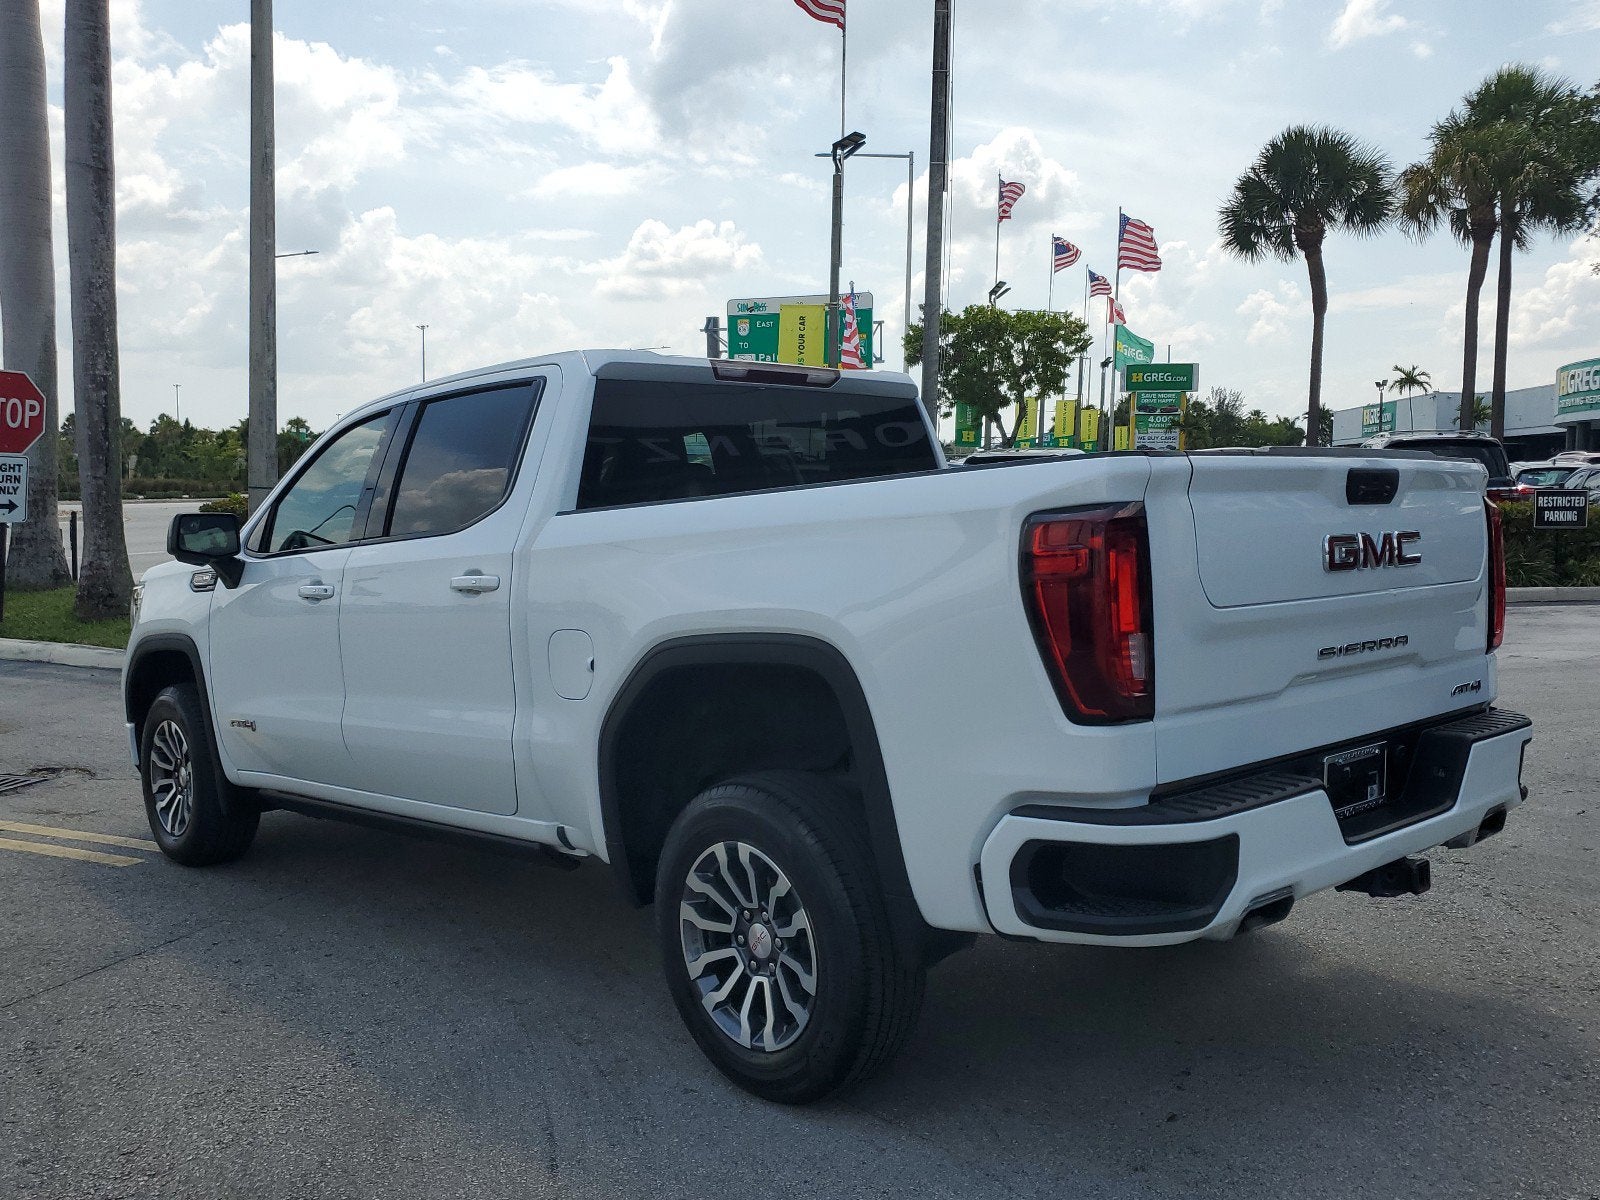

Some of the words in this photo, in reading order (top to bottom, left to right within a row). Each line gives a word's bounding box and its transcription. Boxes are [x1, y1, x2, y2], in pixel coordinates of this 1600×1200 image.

[798, 315, 806, 331] CAR
[798, 334, 806, 354] YOUR
[758, 354, 778, 362] Pal
[0, 463, 23, 472] GHT
[0, 486, 20, 495] NLY
[1538, 496, 1586, 507] RESTRICTED
[1544, 510, 1578, 522] PARKING
[1322, 530, 1422, 573] GMC
[1317, 634, 1409, 660] SIERRA
[1451, 679, 1482, 697] AT4
[752, 930, 767, 951] GMC
